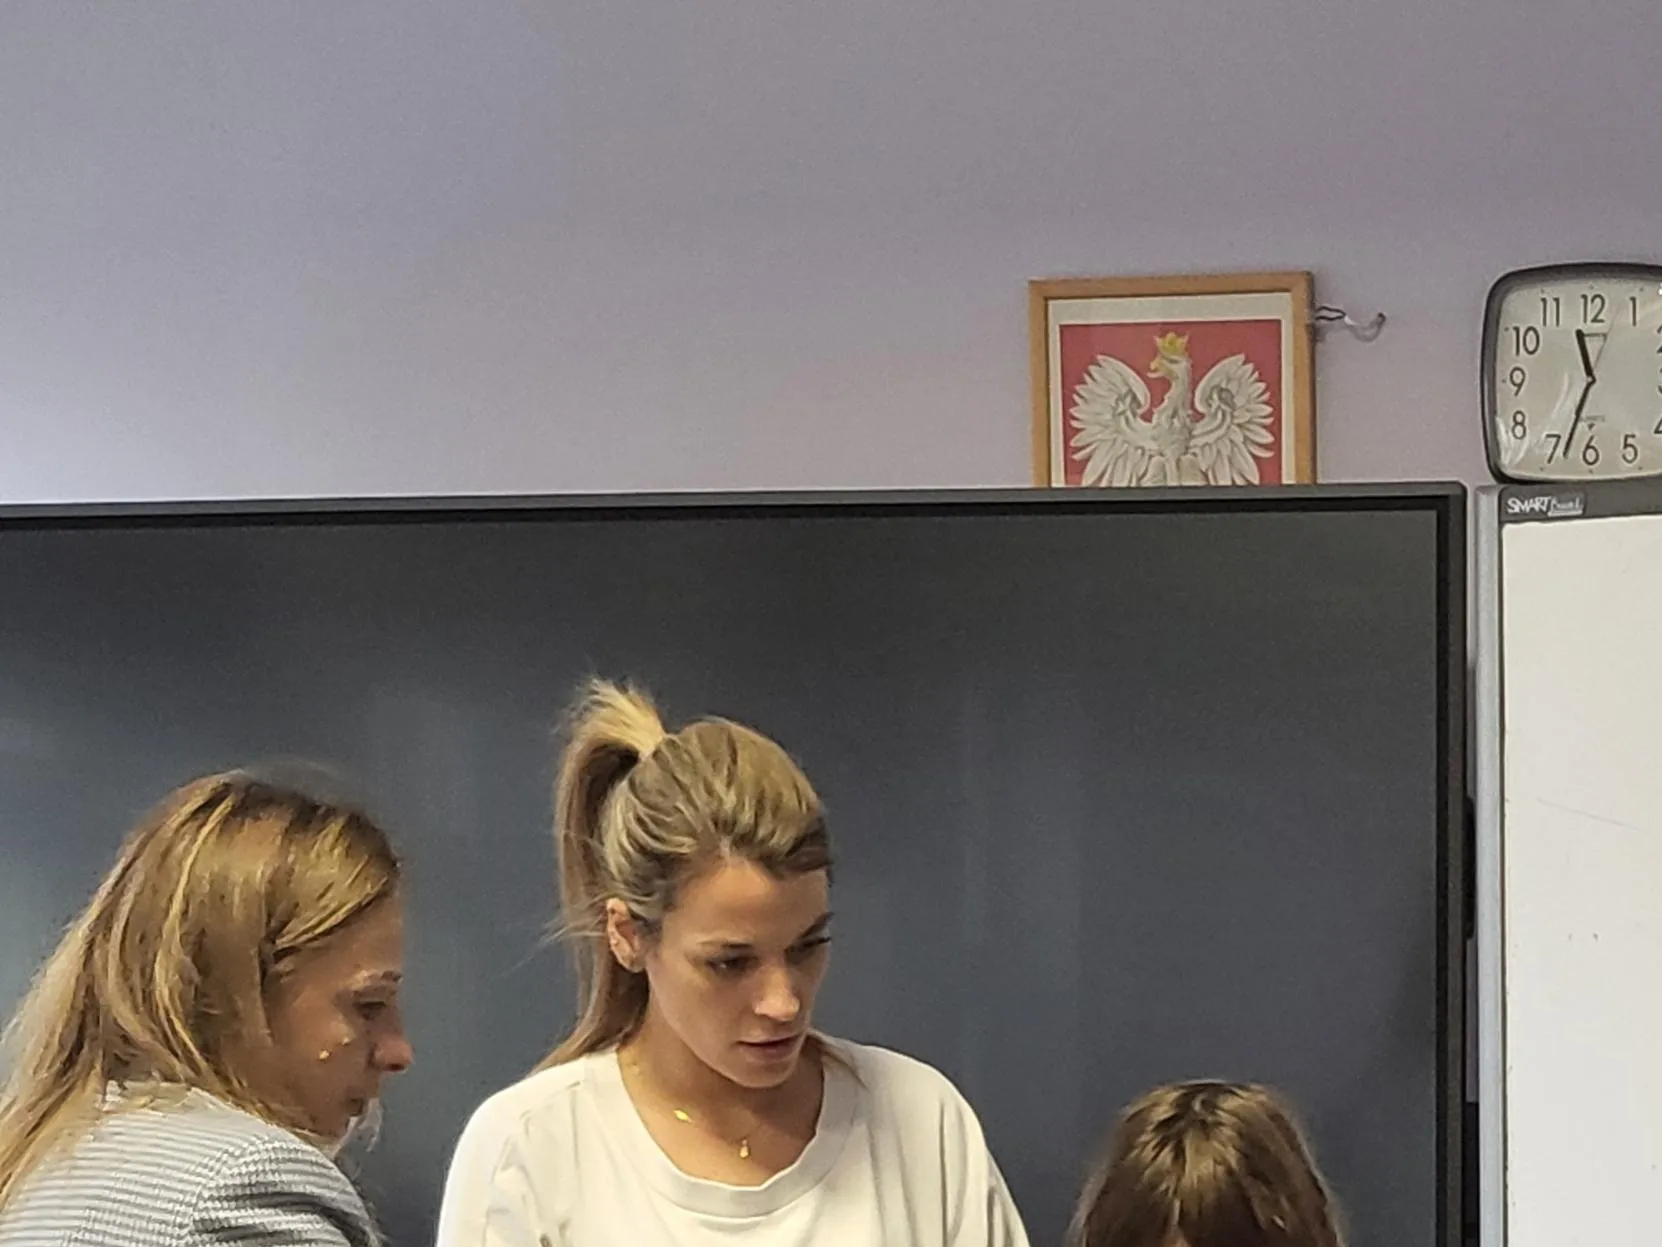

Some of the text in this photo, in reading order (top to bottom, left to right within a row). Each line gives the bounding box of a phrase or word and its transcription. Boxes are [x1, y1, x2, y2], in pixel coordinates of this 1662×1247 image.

[1540, 297, 1561, 327] 11
[1580, 294, 1605, 323] 12
[1629, 296, 1637, 327] 1
[1512, 326, 1540, 357] 10
[1509, 366, 1526, 397] 9
[1511, 409, 1527, 440] 8
[1545, 433, 1562, 464] 7
[1582, 435, 1600, 466] 6
[1621, 434, 1639, 464] 5
[1507, 496, 1551, 513] SMART
